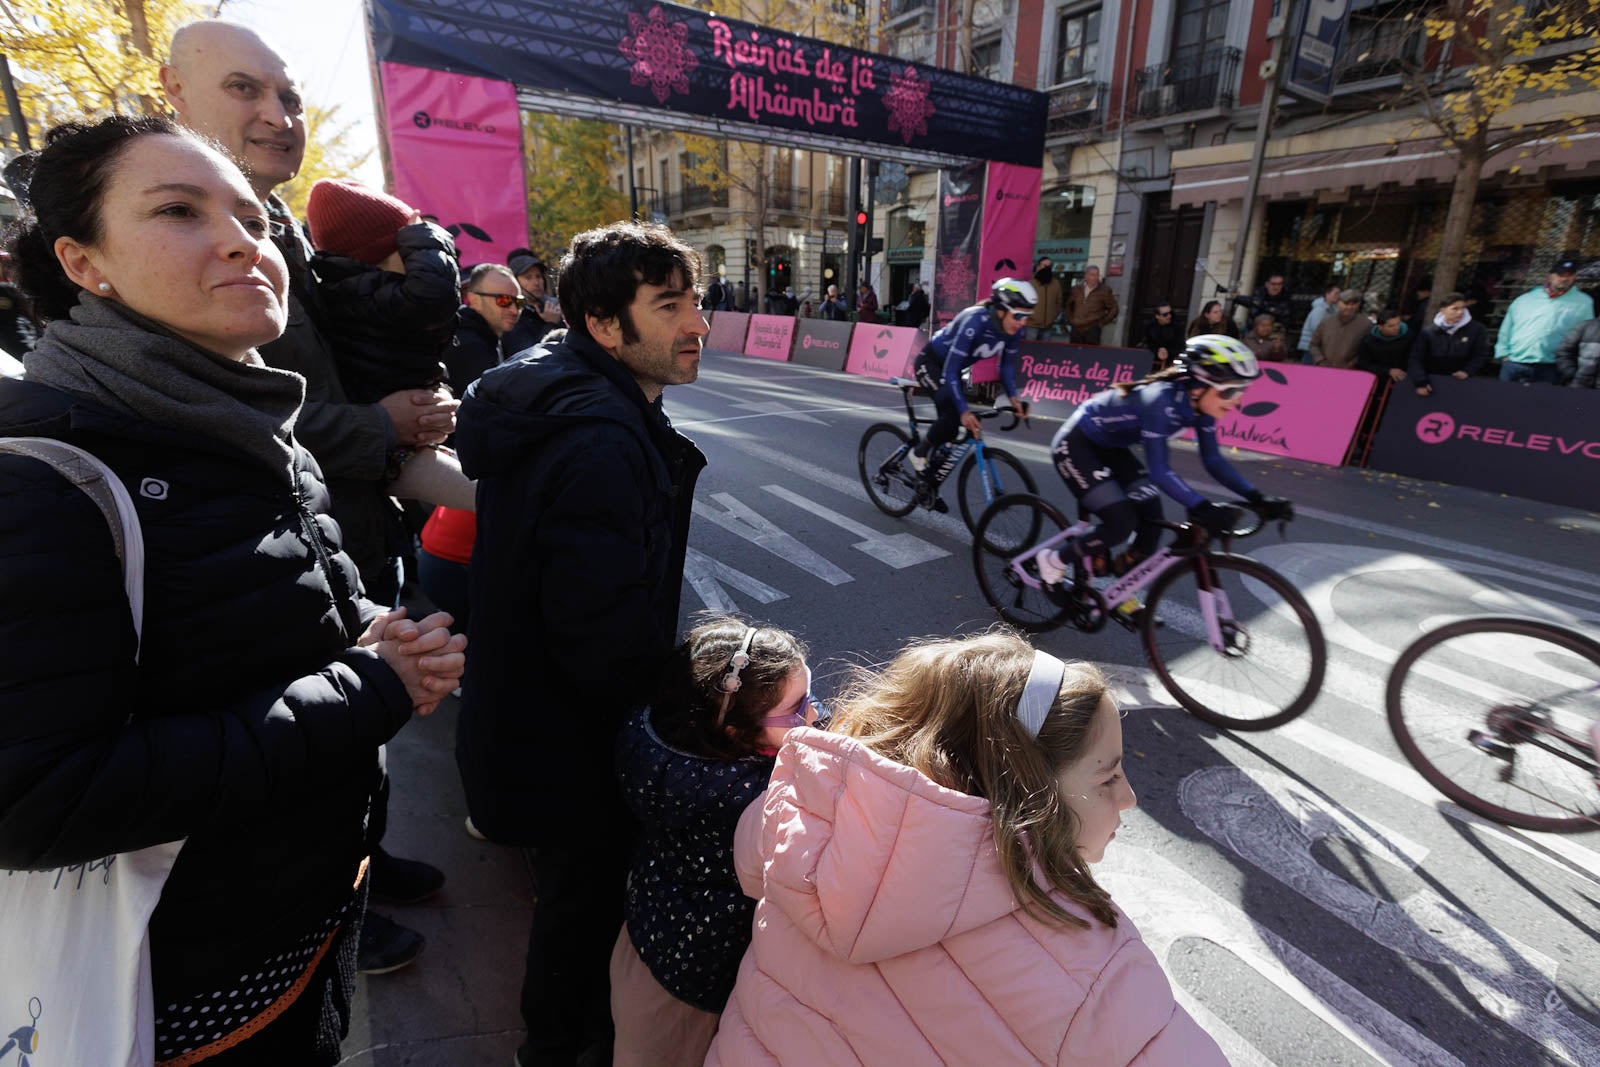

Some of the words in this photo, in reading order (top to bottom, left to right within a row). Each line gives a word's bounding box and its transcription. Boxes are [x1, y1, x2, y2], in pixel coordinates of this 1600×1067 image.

[815, 48, 848, 84] de
[433, 118, 497, 134] RELEVO
[1085, 362, 1119, 381] de
